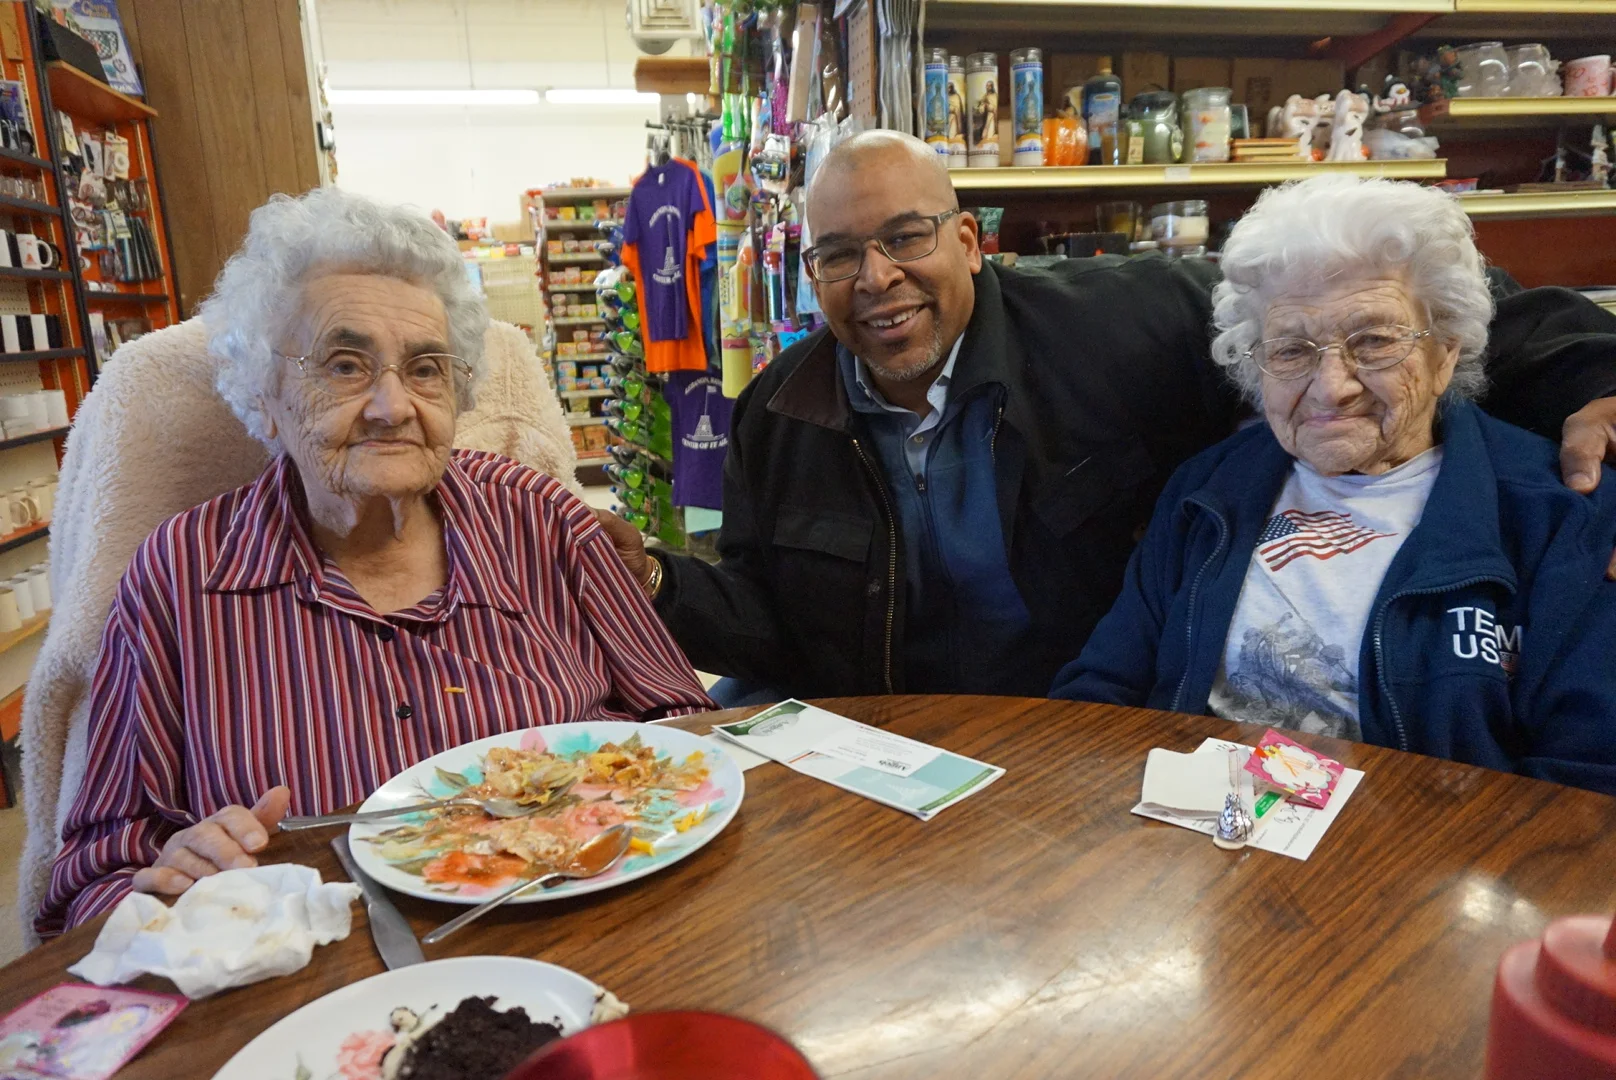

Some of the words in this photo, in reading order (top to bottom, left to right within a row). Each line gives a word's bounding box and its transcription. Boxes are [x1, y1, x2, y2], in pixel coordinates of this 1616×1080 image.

[699, 441, 709, 449] OF
[1447, 607, 1522, 652] TEM
[1453, 634, 1500, 664] US
